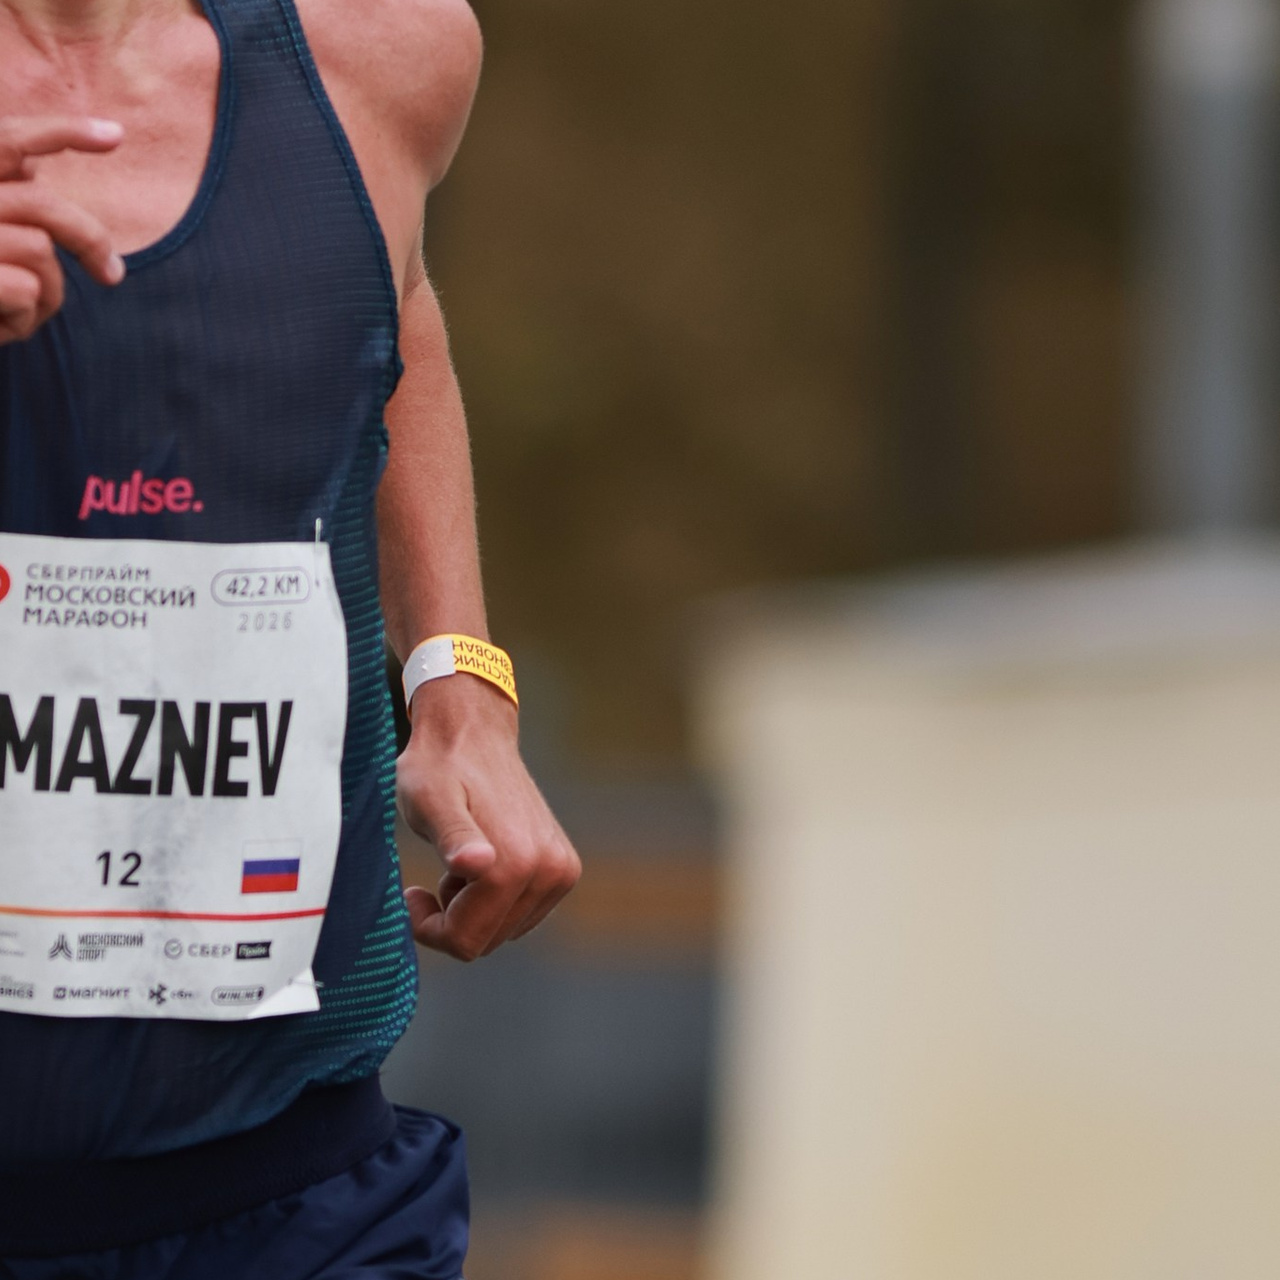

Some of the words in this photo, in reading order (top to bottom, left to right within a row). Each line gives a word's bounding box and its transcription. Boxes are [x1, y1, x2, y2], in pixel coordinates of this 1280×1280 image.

[78, 470, 204, 520] pulse.
[26, 563, 151, 581] СБЕРПРАЙМ
[24, 584, 196, 607] МОСКОВСКИЙ
[226, 577, 268, 597] 42,2
[23, 607, 148, 628] МАРАФОН
[96, 850, 143, 888] 12
